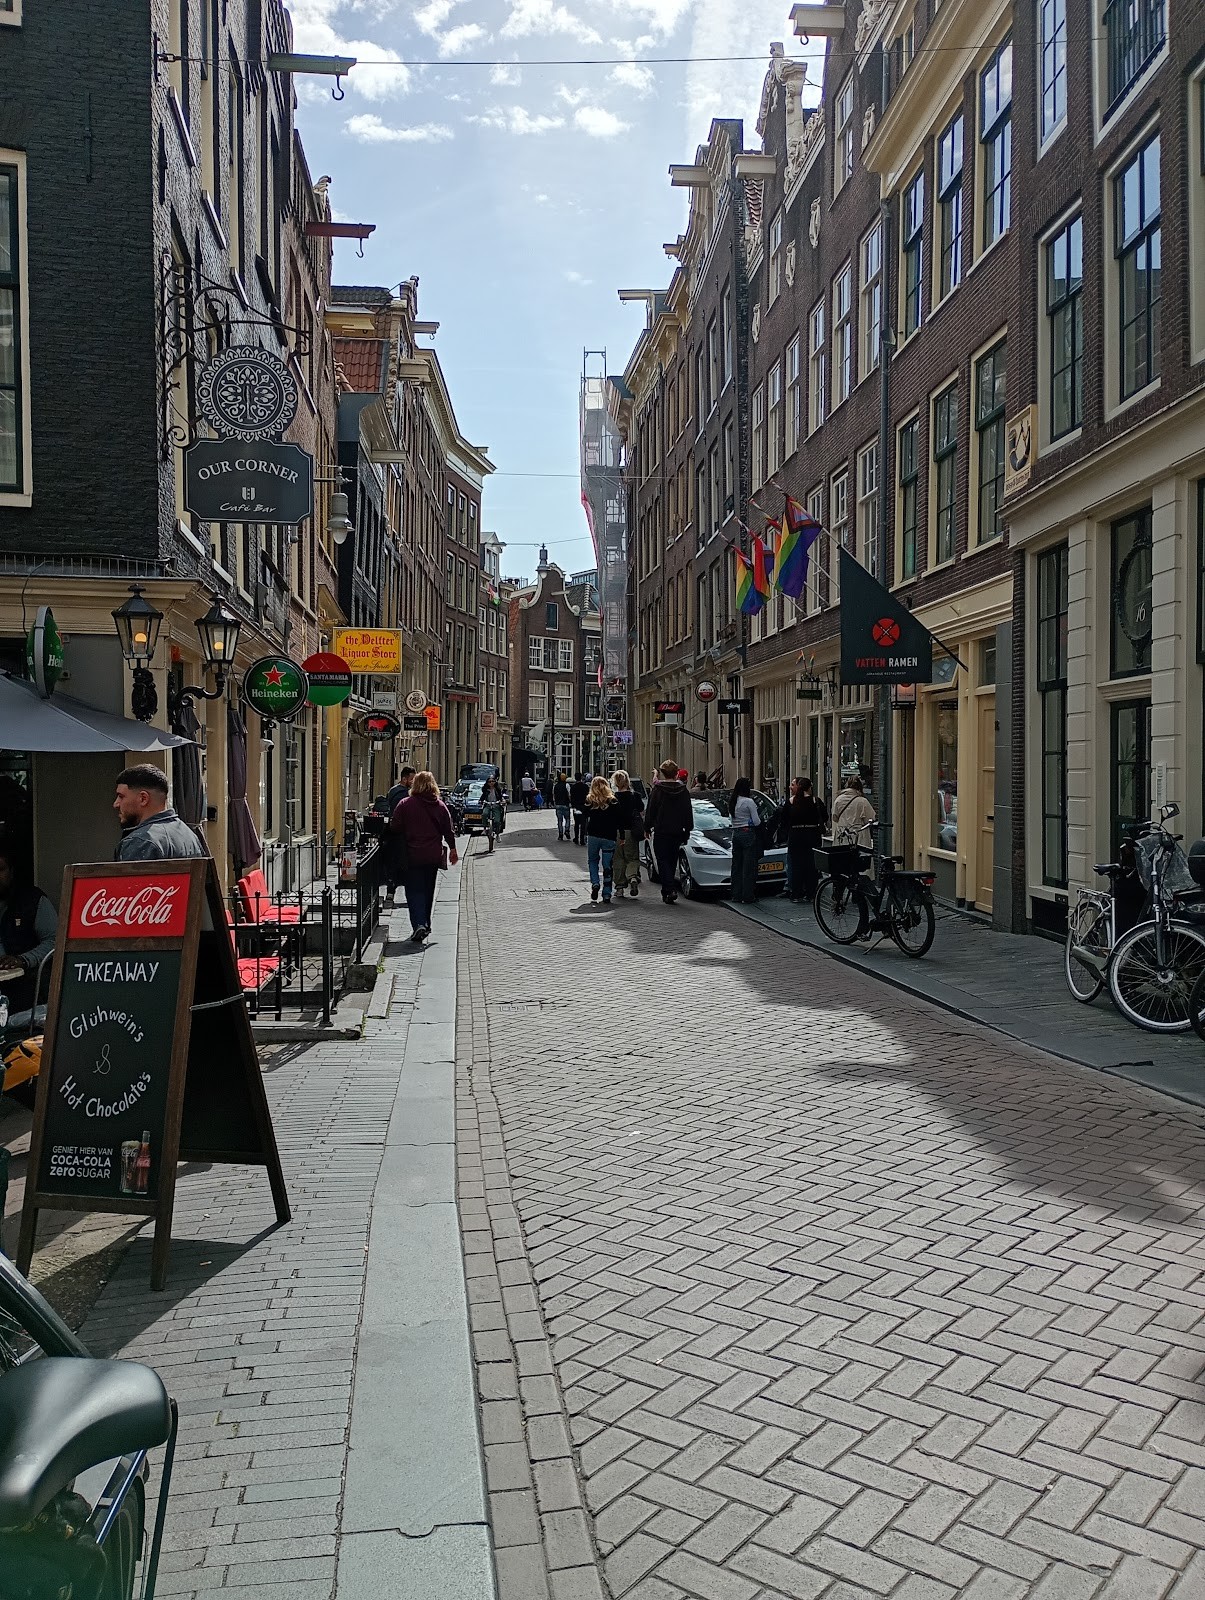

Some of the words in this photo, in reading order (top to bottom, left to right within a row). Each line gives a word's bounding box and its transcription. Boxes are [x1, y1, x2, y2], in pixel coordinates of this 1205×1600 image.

[198, 460, 232, 480] OUR
[235, 459, 299, 484] CORNER
[219, 502, 251, 512] Café
[253, 503, 277, 513] Bar
[1135, 602, 1146, 622] 16
[345, 635, 359, 645] the
[341, 646, 370, 659] Liquor
[371, 646, 397, 659] Store
[855, 658, 886, 668] VATTEN
[888, 656, 918, 667] RAMEN
[251, 688, 299, 699] Heineken
[81, 886, 181, 926] Coca-Cola
[74, 961, 160, 983] TAKEAWAY
[69, 1005, 144, 1042] Glühwein's
[59, 1075, 85, 1110] Hot
[85, 1071, 151, 1117] Chocolate's
[52, 1145, 78, 1154] GENIET
[79, 1146, 97, 1155] HIER
[97, 1147, 113, 1156] VAN
[50, 1154, 111, 1168] COCA-COLA
[49, 1165, 76, 1177] zero
[76, 1167, 111, 1179] SUGAR
